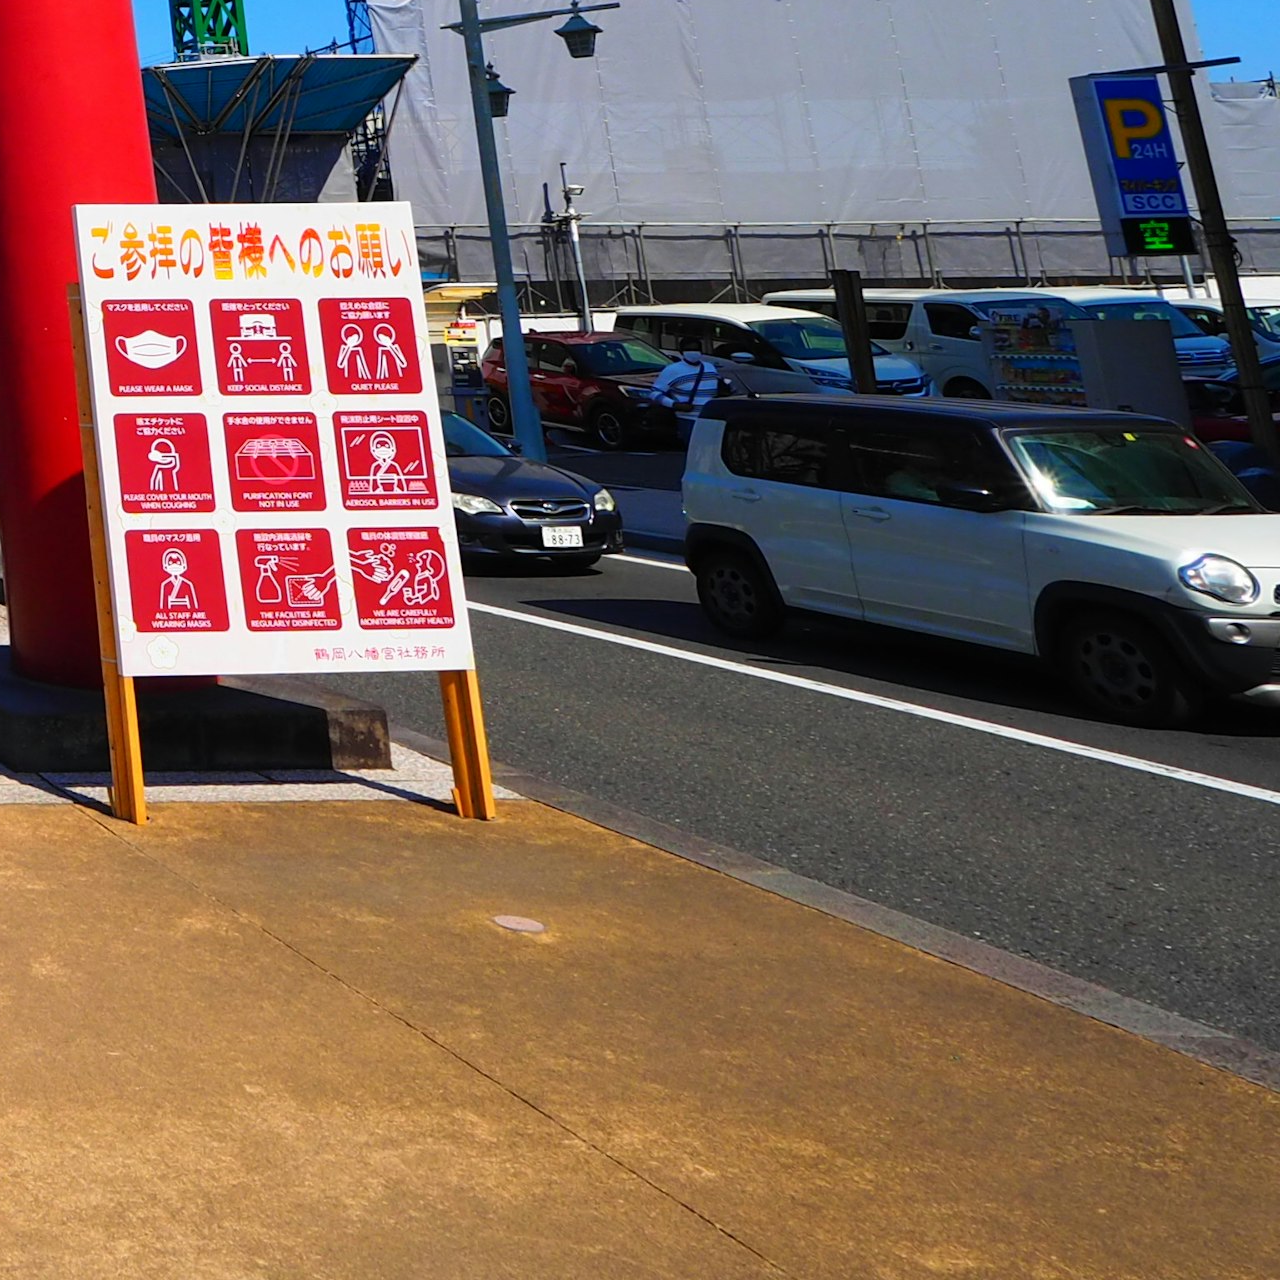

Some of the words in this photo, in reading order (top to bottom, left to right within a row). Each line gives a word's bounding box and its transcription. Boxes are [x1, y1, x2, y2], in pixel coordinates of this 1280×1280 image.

[1103, 99, 1163, 159] P
[1131, 143, 1168, 159] 24H
[1132, 195, 1176, 209] SCC
[1139, 220, 1174, 249] 空
[91, 220, 413, 281] ご参拝の皆様へのお願い
[118, 385, 143, 393] PLEASE
[144, 385, 165, 393] WEAR
[173, 385, 193, 393] MASK
[227, 384, 243, 392] KEEP
[244, 384, 269, 392] SOCIAL
[270, 384, 303, 392] DISTANCE
[351, 383, 373, 391] QUIET
[374, 383, 399, 391] PLEASE
[188, 493, 212, 501] MOUTH
[243, 492, 292, 500] PURIFICATION
[293, 492, 313, 500] FONT
[161, 501, 197, 509] COUGHING
[259, 500, 276, 508] NOT
[285, 500, 300, 508] USE
[345, 499, 378, 507] AEROSOL
[379, 499, 411, 507] BARRIERS
[422, 498, 436, 506] USE
[155, 612, 169, 620] ALL
[169, 612, 190, 620] STAFF
[260, 611, 274, 619] THE
[274, 611, 310, 619] FACILITIES
[400, 609, 437, 617] CAREFULLY
[152, 621, 186, 629] WEARING
[187, 620, 212, 628] MASKS
[251, 620, 290, 628] REGULARLY
[291, 619, 337, 627] DISINFECTED
[360, 618, 404, 626] MONITORING
[427, 617, 454, 625] HEALTH
